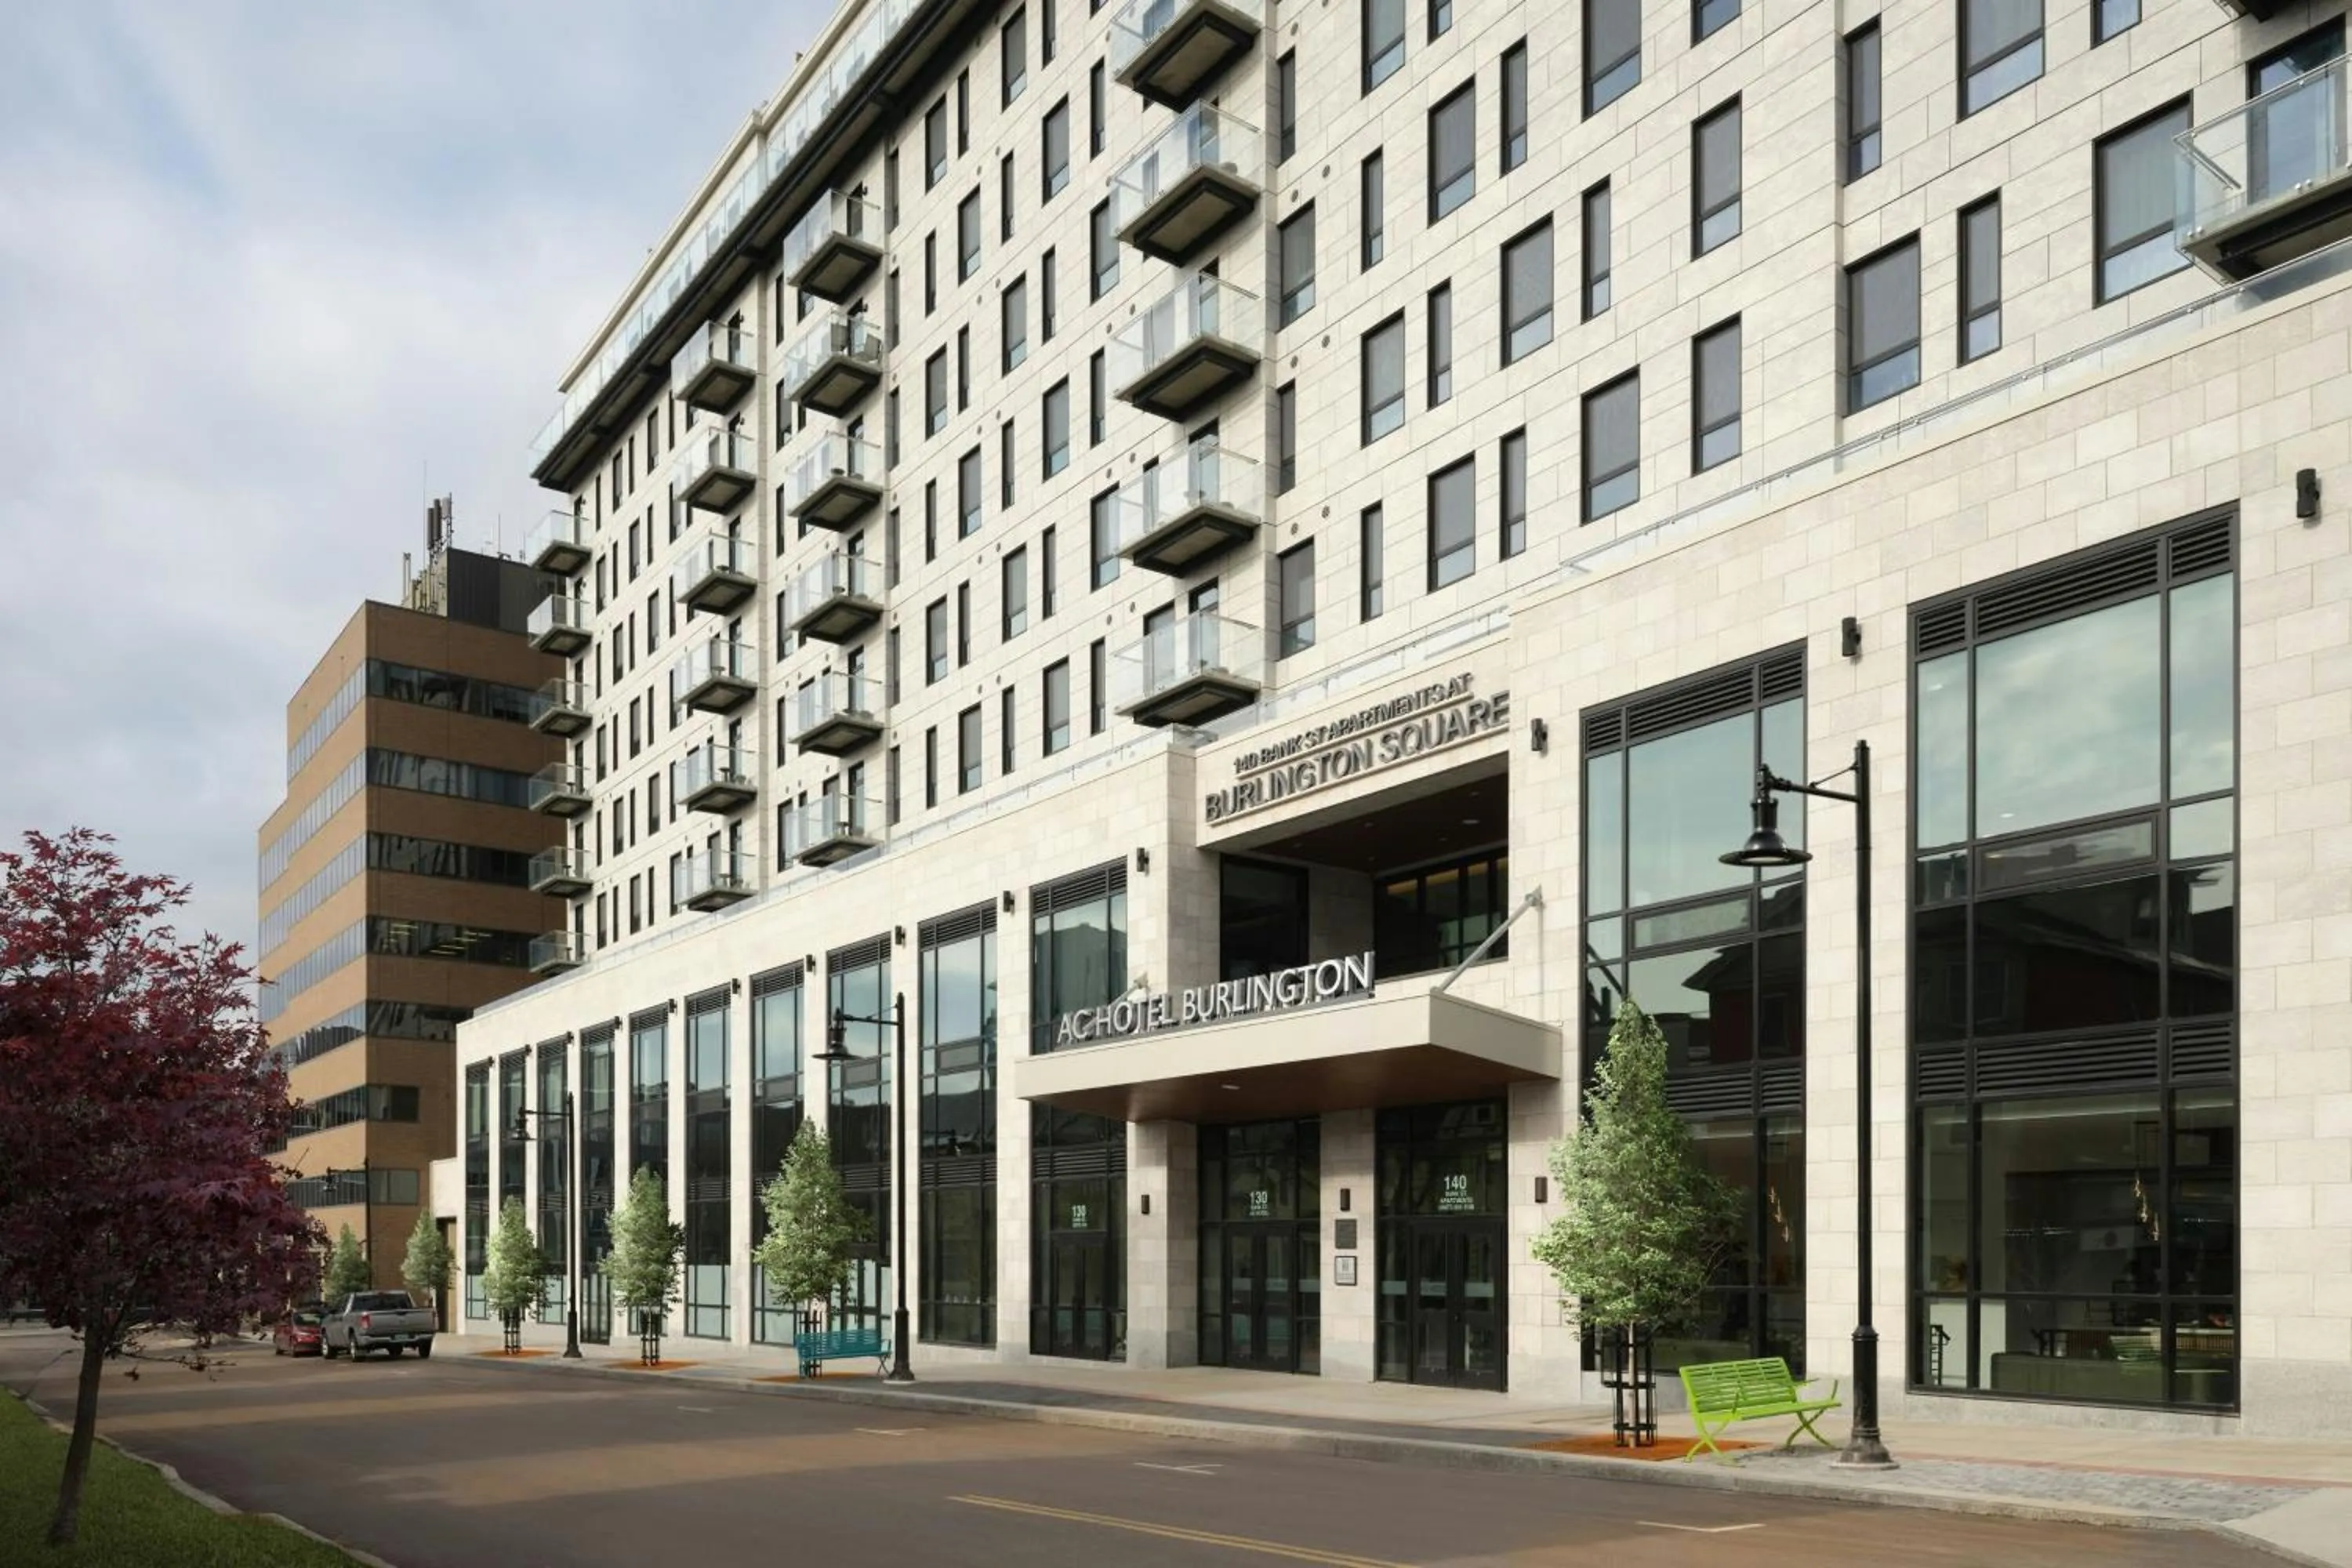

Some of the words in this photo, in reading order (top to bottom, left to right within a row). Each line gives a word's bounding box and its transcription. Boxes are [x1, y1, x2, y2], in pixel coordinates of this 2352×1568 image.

[1206, 739, 1374, 822] BURLINGTON
[1378, 690, 1510, 764] SQUARE
[1233, 752, 1258, 774] 140
[1261, 735, 1302, 764] BANK
[1305, 725, 1328, 747] ST
[1328, 684, 1446, 741] APARTMENTS
[1448, 672, 1474, 699] AT
[1057, 1008, 1094, 1045] AC
[1096, 993, 1174, 1036] HOTEL
[1182, 951, 1375, 1021] BURLINGTON
[1250, 1191, 1268, 1204] 130
[1444, 1175, 1467, 1190] 140
